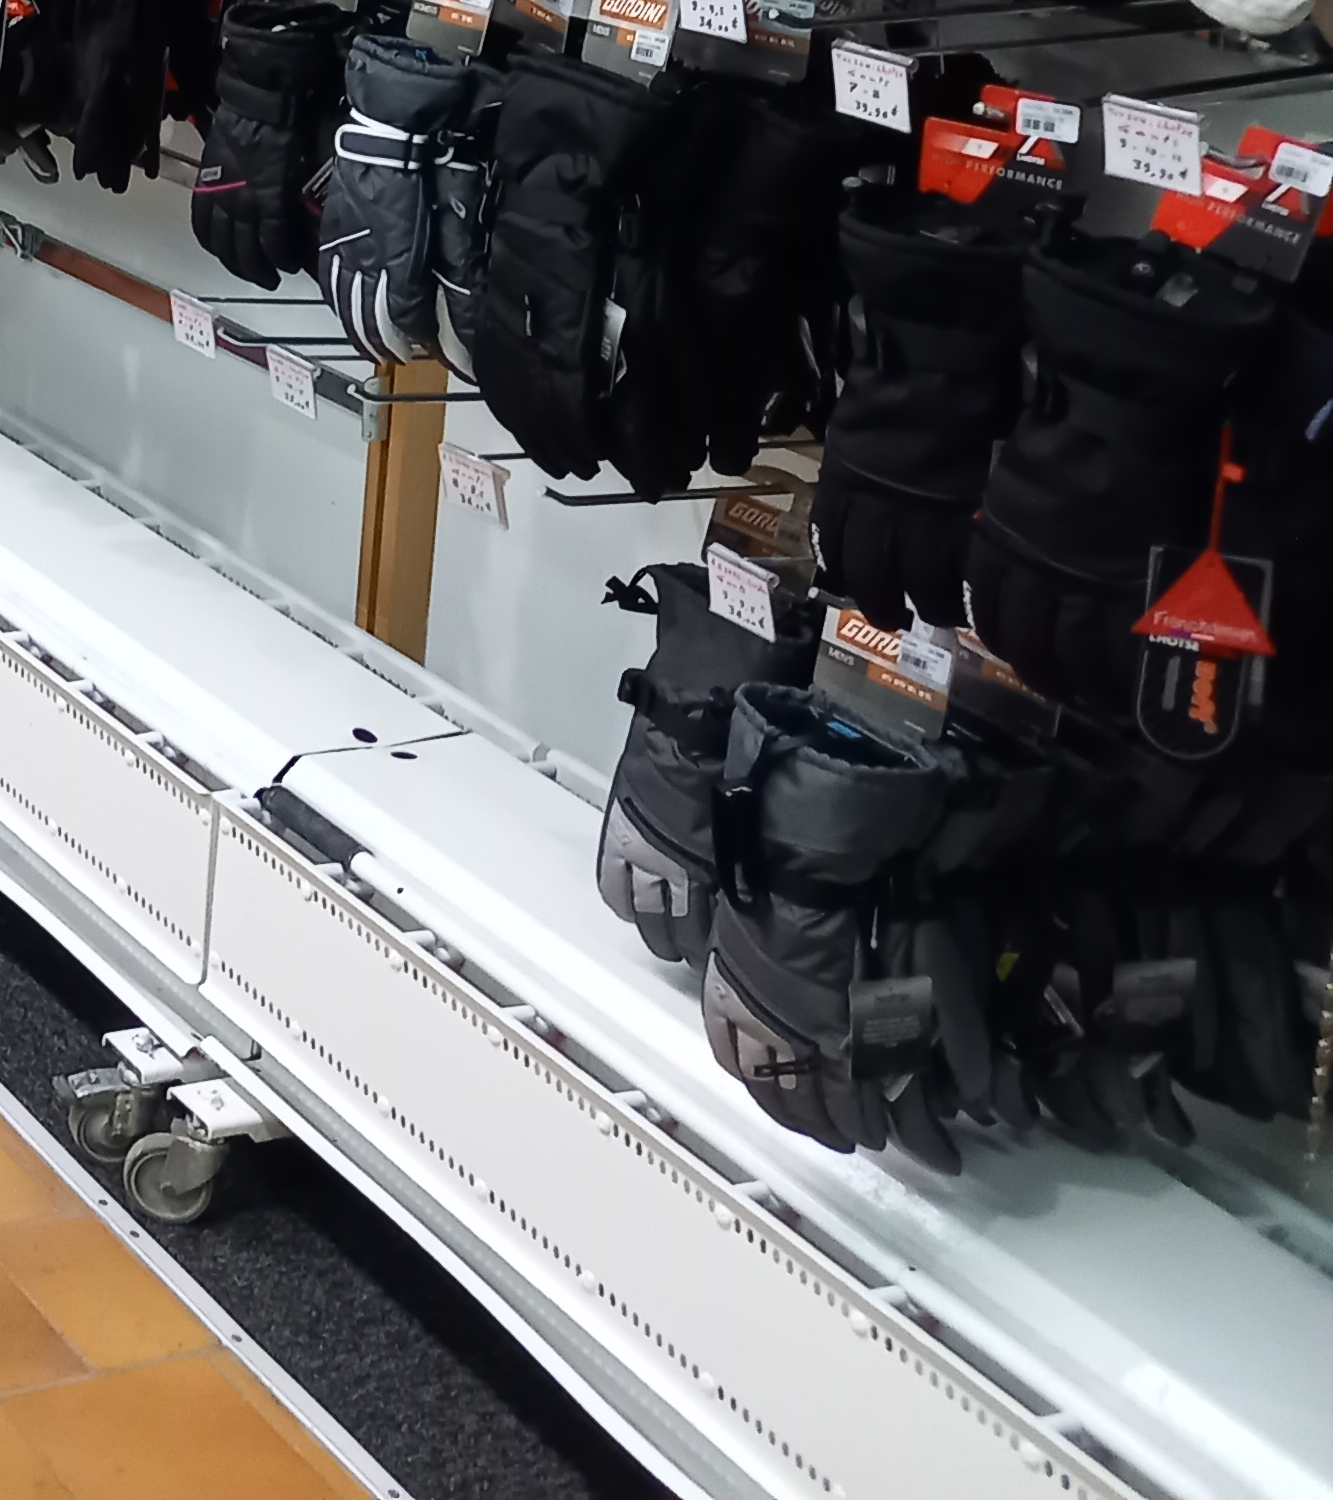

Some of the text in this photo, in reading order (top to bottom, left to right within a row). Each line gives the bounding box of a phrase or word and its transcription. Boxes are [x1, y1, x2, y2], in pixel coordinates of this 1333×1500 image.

[965, 160, 1063, 191] PERFORMANCE
[728, 500, 778, 535] GORD
[838, 617, 902, 663] GORD
